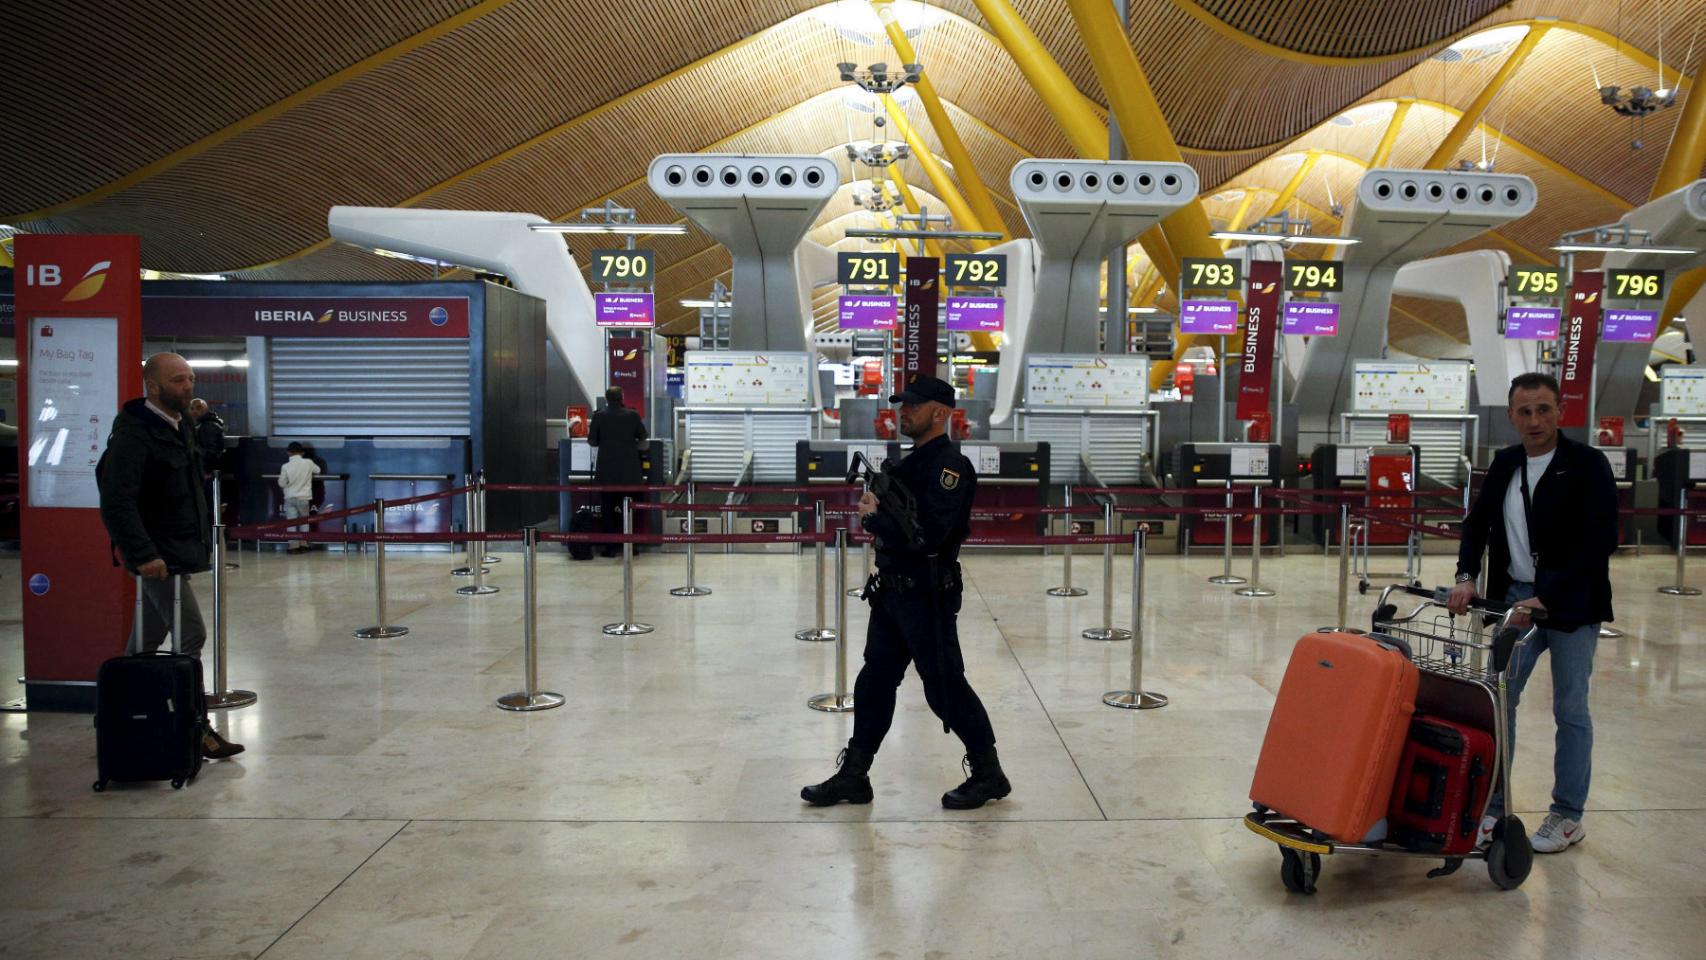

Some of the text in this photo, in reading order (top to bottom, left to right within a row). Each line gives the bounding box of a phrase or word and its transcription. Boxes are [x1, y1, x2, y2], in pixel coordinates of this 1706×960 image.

[27, 264, 62, 286] IB
[600, 255, 647, 277] 790
[848, 258, 889, 280] 791
[953, 260, 999, 282] 792
[1191, 264, 1234, 285] 793
[1292, 266, 1337, 287] 794
[910, 279, 921, 287] IB
[1252, 282, 1263, 290] IB
[1516, 271, 1558, 293] 795
[1616, 275, 1658, 296] 796
[1575, 292, 1585, 300] IB
[255, 311, 408, 322] IBERIA BUSINESS
[908, 304, 920, 371] BUSINESS
[1244, 307, 1261, 373] BUSINESS
[40, 349, 94, 361] My Bag Tag
[613, 349, 624, 357] IB
[1565, 317, 1582, 380] BUSINESS
